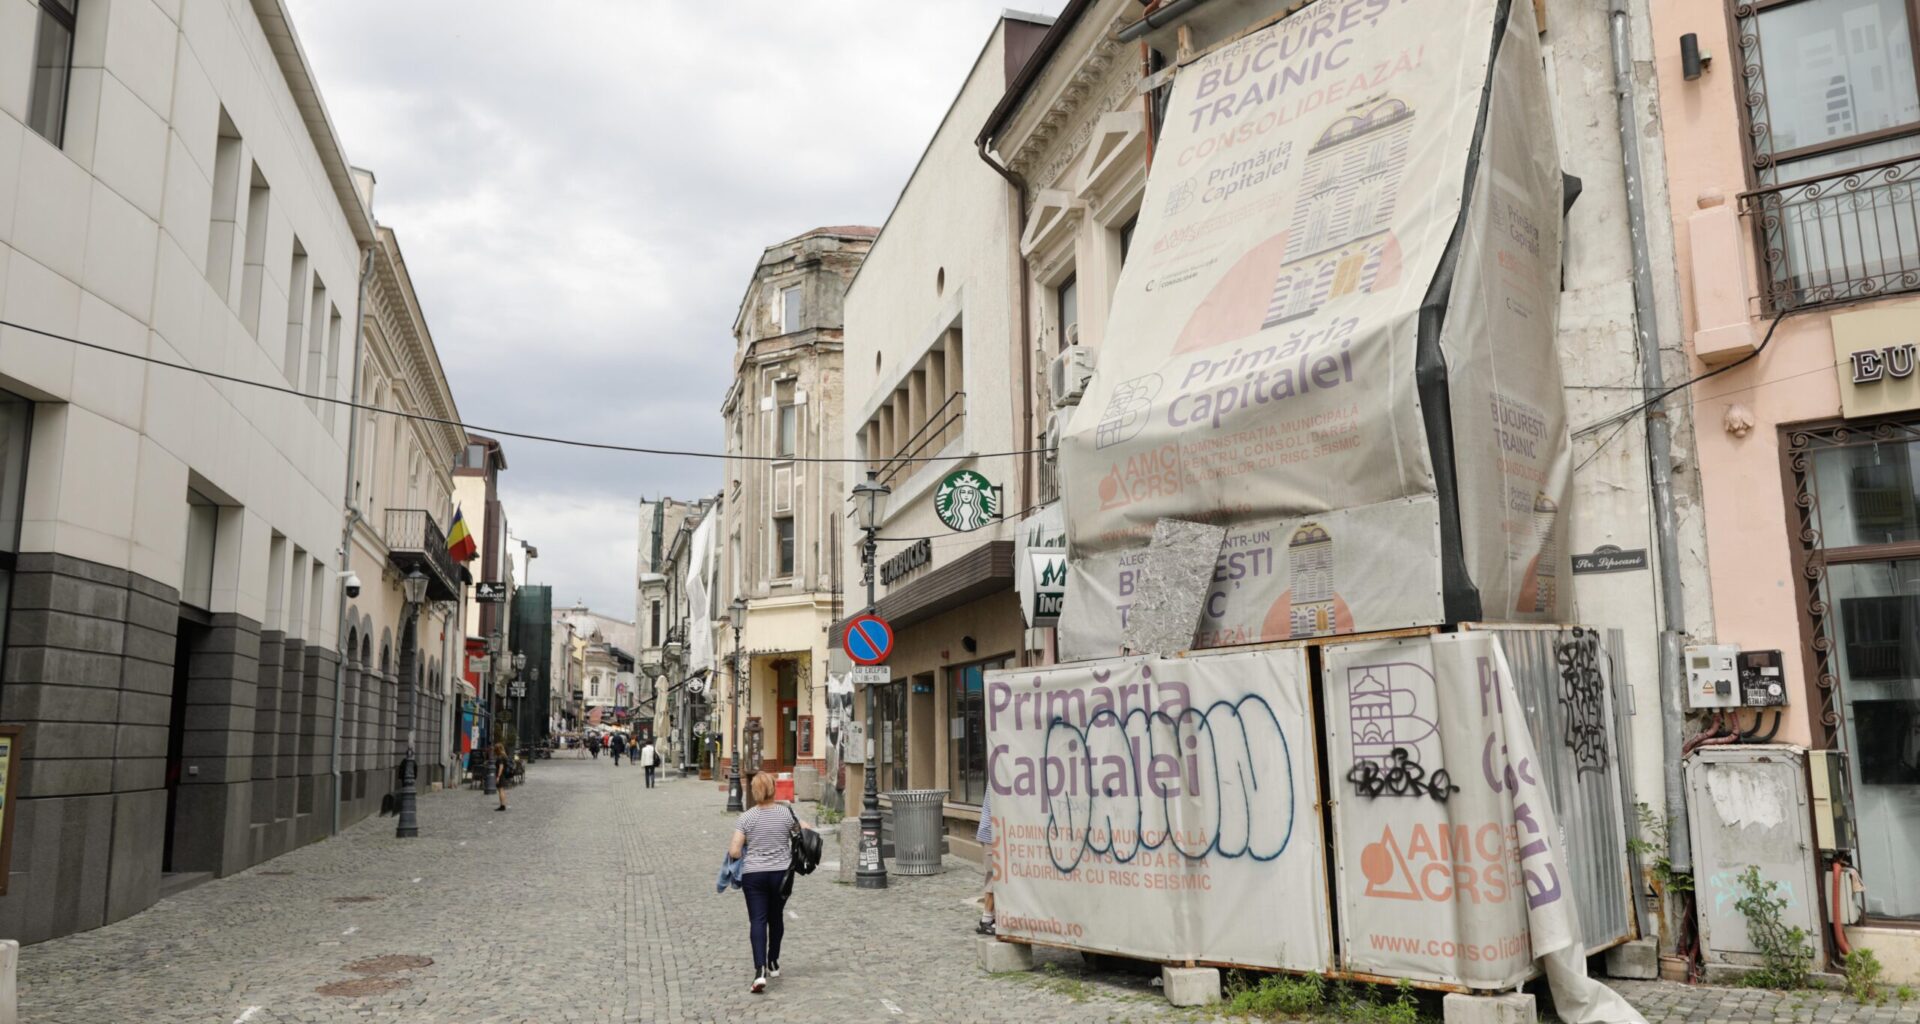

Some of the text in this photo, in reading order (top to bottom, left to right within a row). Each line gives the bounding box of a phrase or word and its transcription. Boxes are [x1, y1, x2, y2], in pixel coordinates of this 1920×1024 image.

[1177, 44, 1425, 167] CONSOLIDEAZĂ!
[1188, 38, 1354, 134] TRAINIC
[1201, 153, 1292, 203] Capitalei
[1207, 140, 1293, 186] Primăria
[1180, 316, 1359, 389] Primăria
[1849, 344, 1920, 384] EU
[1167, 339, 1353, 429] Capitalei
[1125, 443, 1179, 480] AMC
[1131, 471, 1180, 502] CRS
[880, 539, 929, 585] STARBUCKS
[988, 665, 1193, 731] Primăria
[988, 735, 1201, 813] Capitalei
[1009, 844, 1063, 861] PENTRU
[1408, 823, 1501, 862] AMC
[1086, 868, 1105, 884] CU
[1109, 870, 1140, 887] RISC
[1144, 873, 1212, 890] SEISMIC
[1420, 863, 1506, 904] CRS
